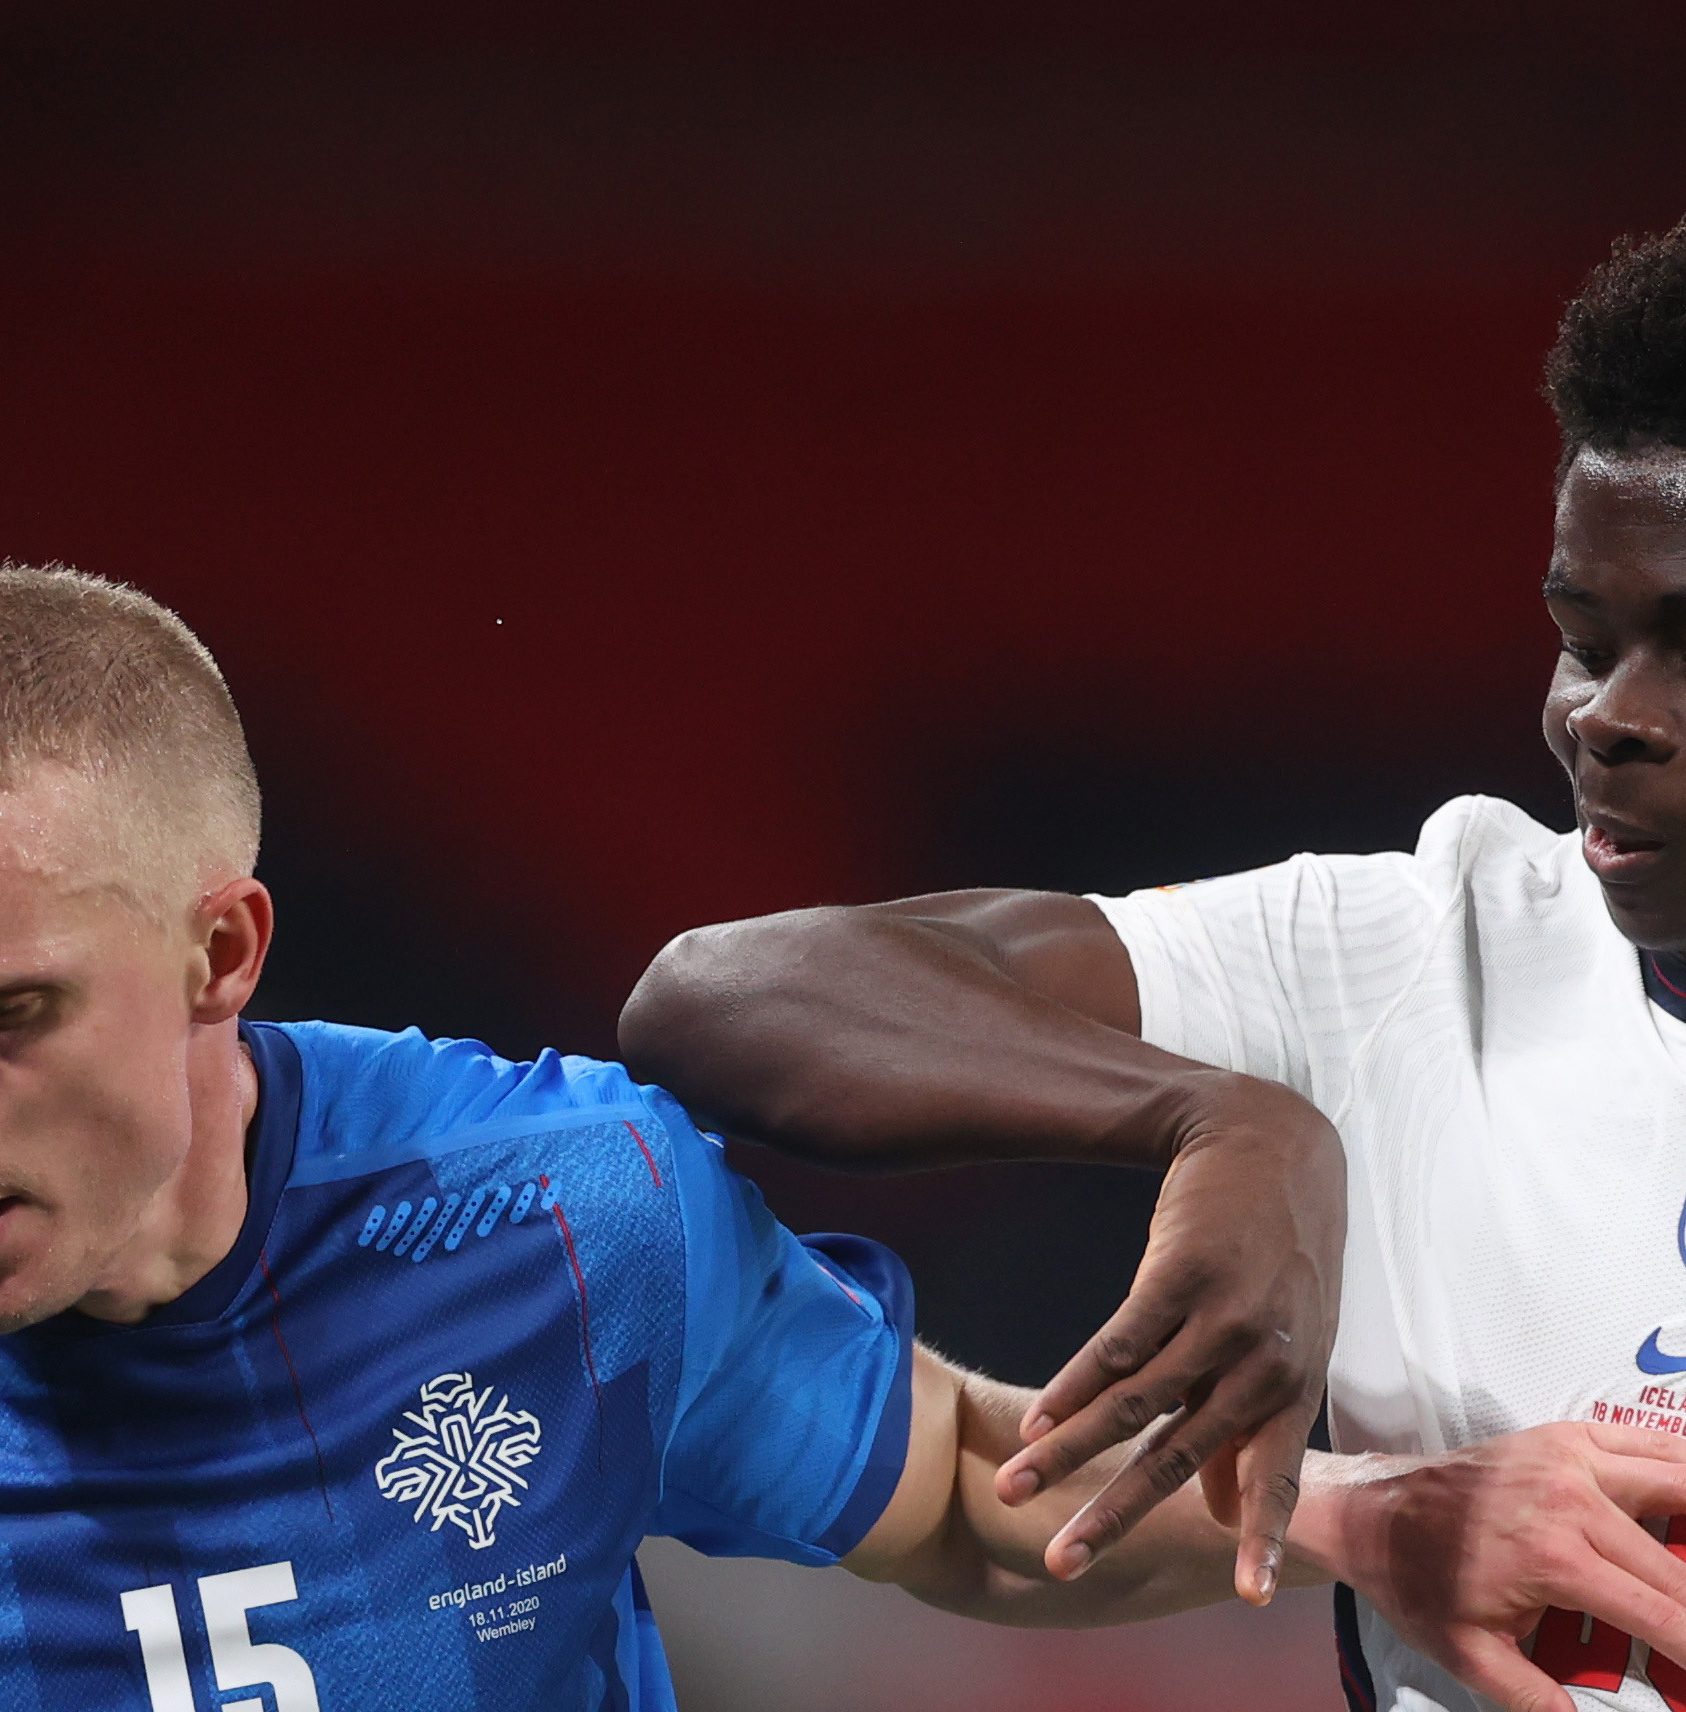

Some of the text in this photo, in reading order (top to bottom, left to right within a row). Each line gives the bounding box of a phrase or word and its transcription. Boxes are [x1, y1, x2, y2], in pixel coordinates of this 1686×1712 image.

[1592, 1400, 1608, 1422] 18
[429, 1553, 567, 1610] england-island
[468, 1595, 540, 1627] 18.11.2020
[476, 1616, 536, 1643] Wembley
